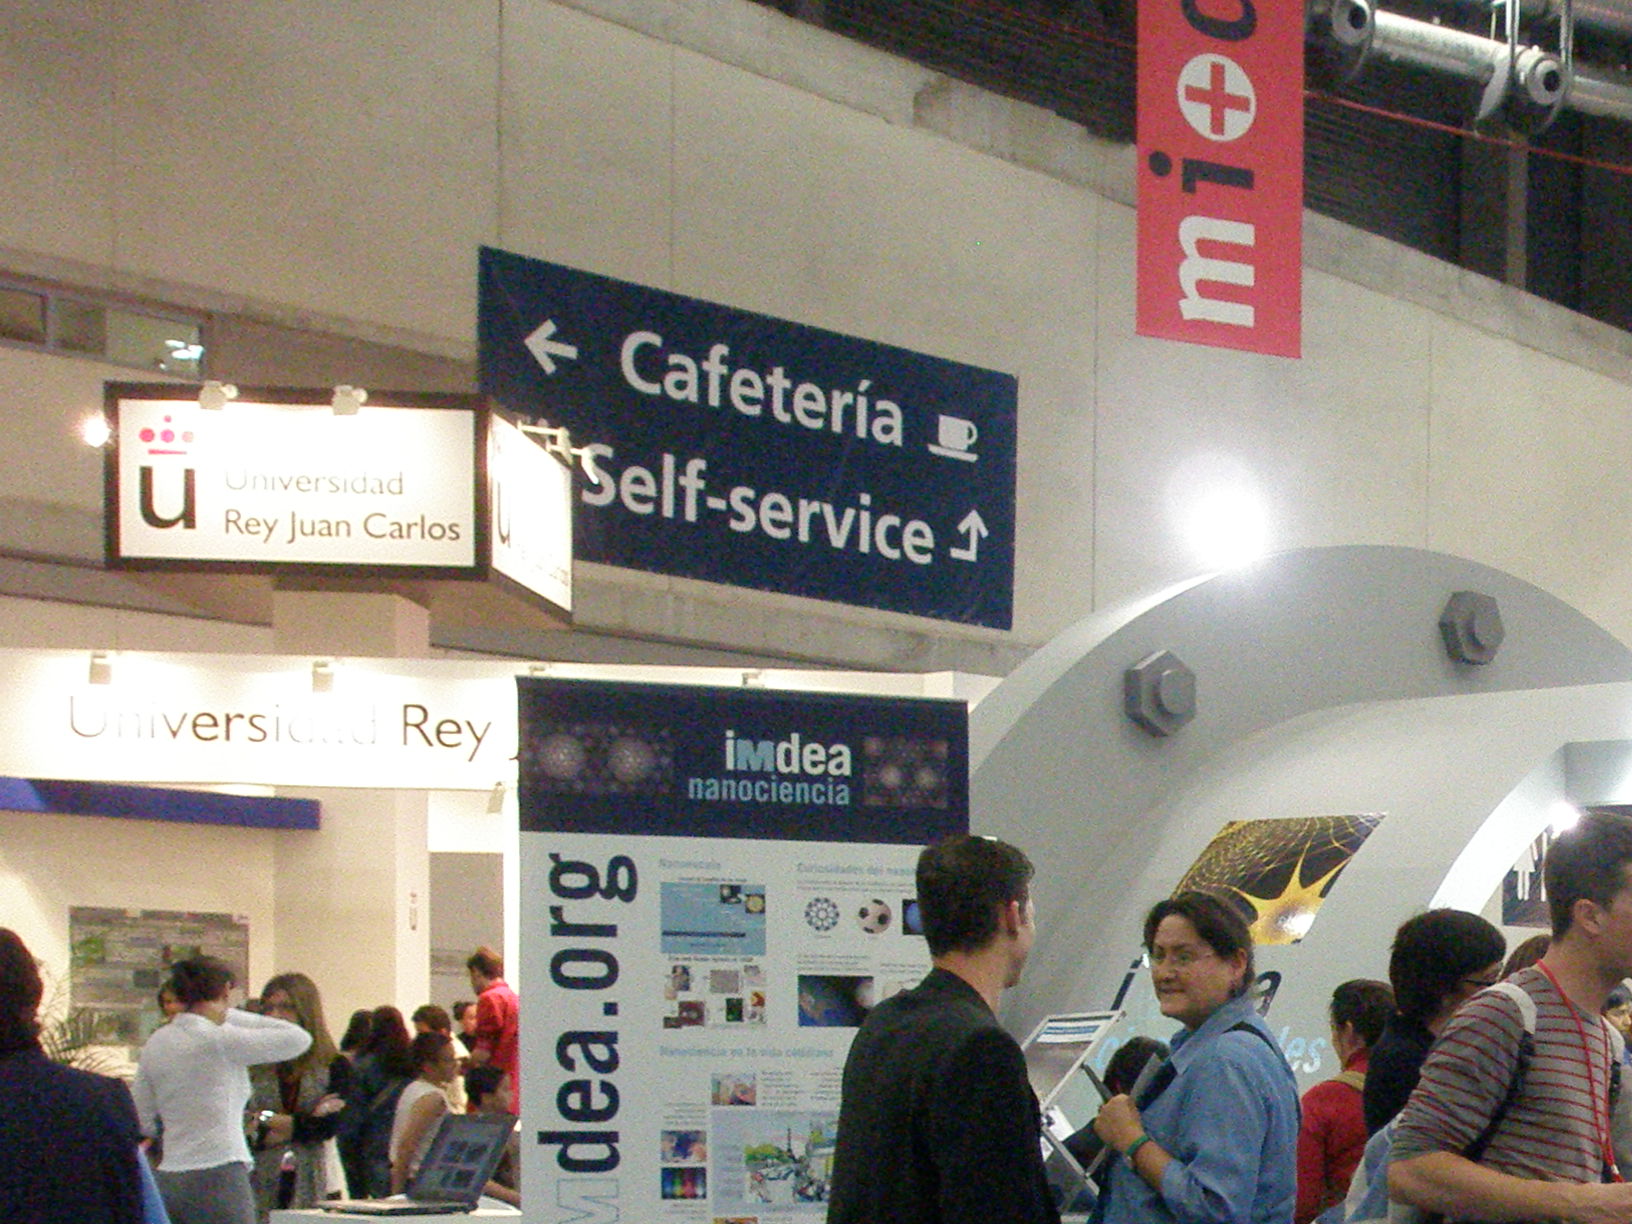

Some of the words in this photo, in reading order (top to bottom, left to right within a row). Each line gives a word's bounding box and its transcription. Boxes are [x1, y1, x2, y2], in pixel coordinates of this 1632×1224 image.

[619, 329, 904, 447] Cafetería
[224, 468, 404, 497] Universidad
[581, 442, 936, 566] Self-service
[224, 508, 279, 544] Rey
[286, 510, 352, 545] Juan
[363, 512, 462, 541] Carlos
[402, 703, 493, 763] Rey
[688, 775, 850, 806] nanociencia
